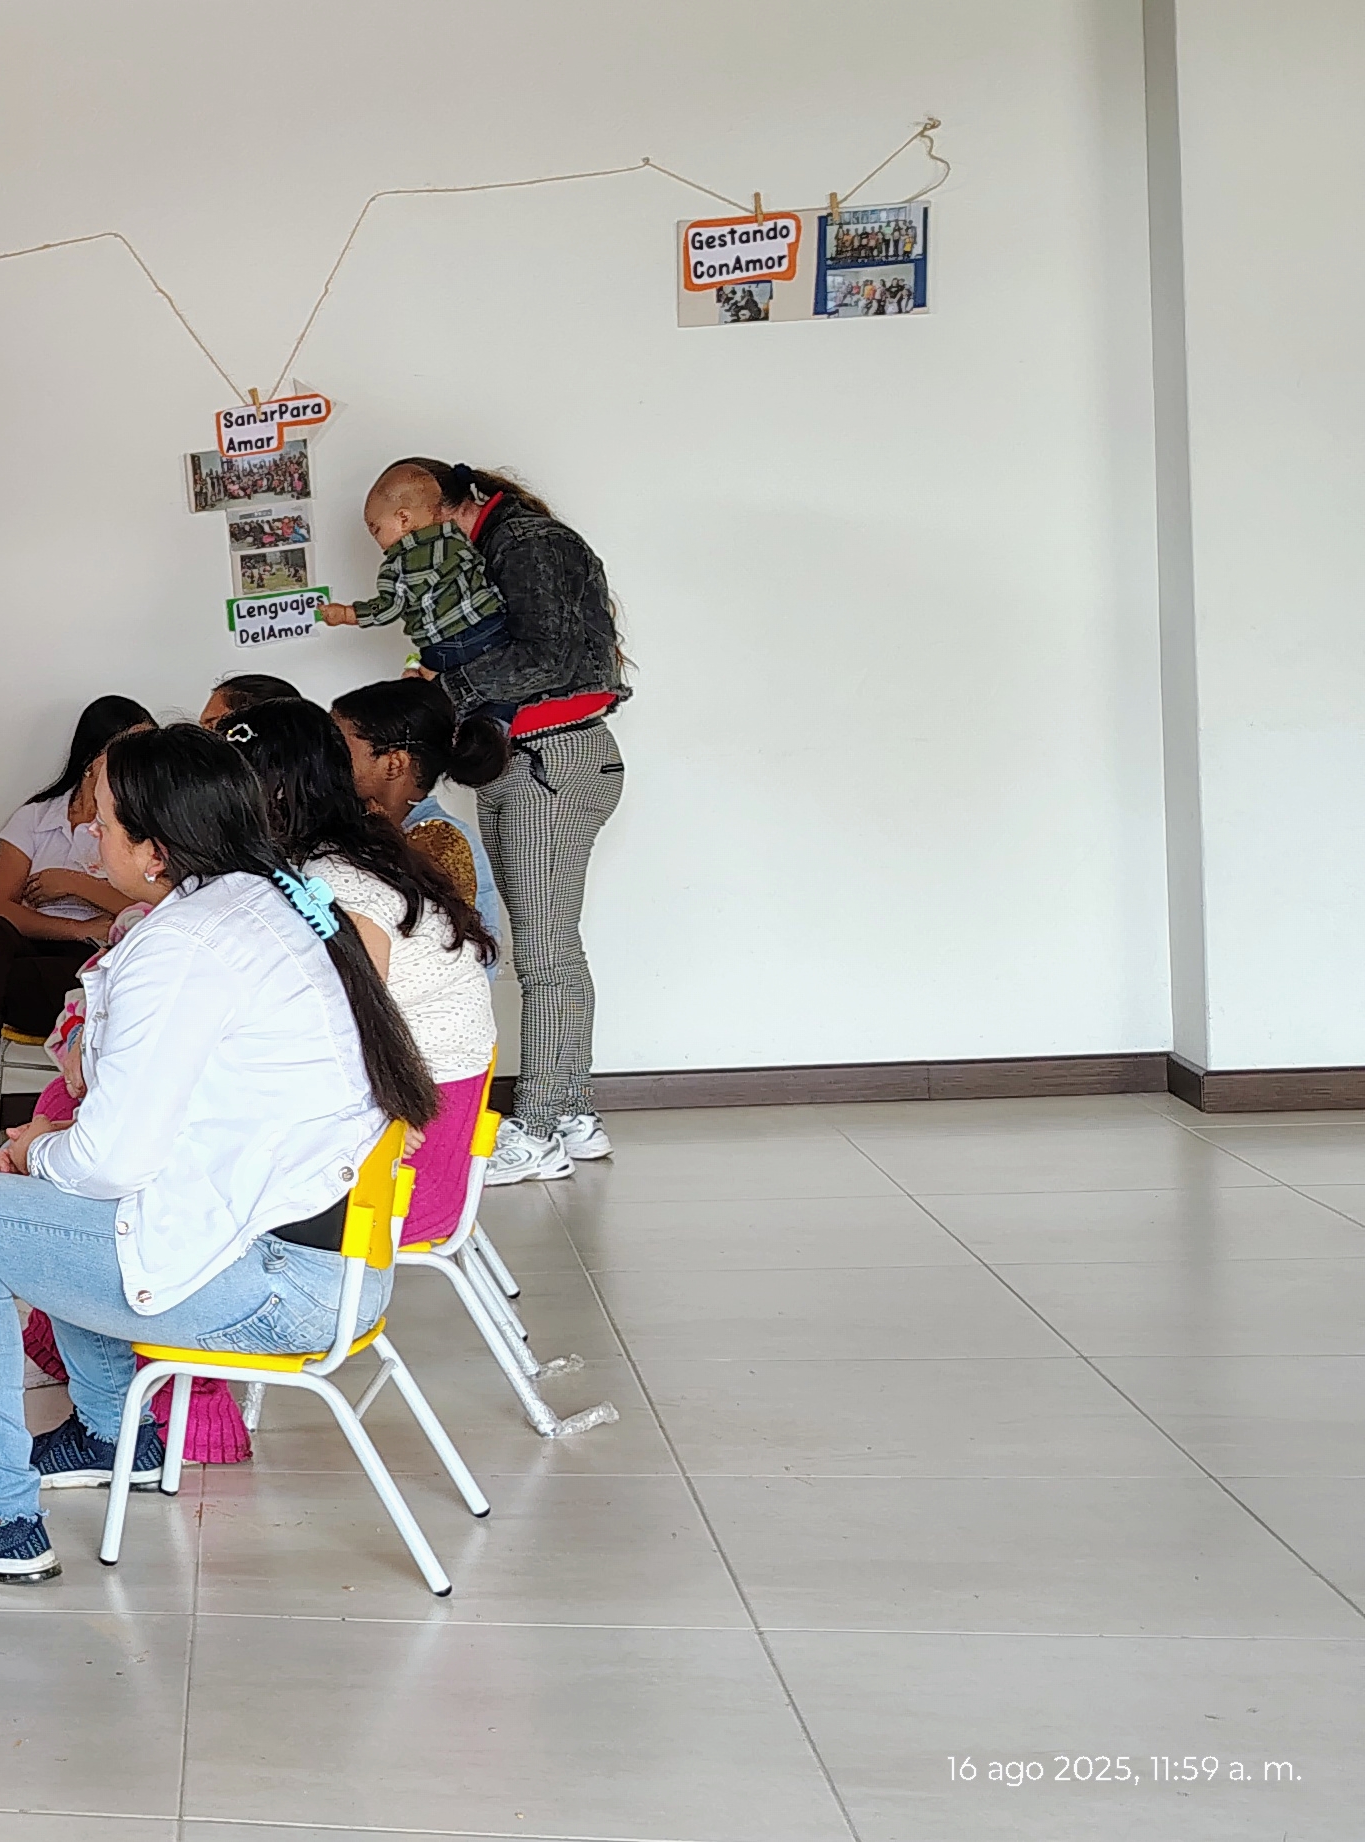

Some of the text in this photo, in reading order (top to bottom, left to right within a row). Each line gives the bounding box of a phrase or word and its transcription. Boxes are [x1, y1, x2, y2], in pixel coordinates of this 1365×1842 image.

[691, 221, 791, 251] Gestando
[693, 254, 787, 280] ConAmor
[223, 402, 323, 429] SanarPara
[226, 434, 275, 454] Amar
[236, 594, 325, 620] Lenguajes
[240, 624, 314, 644] DelAmor
